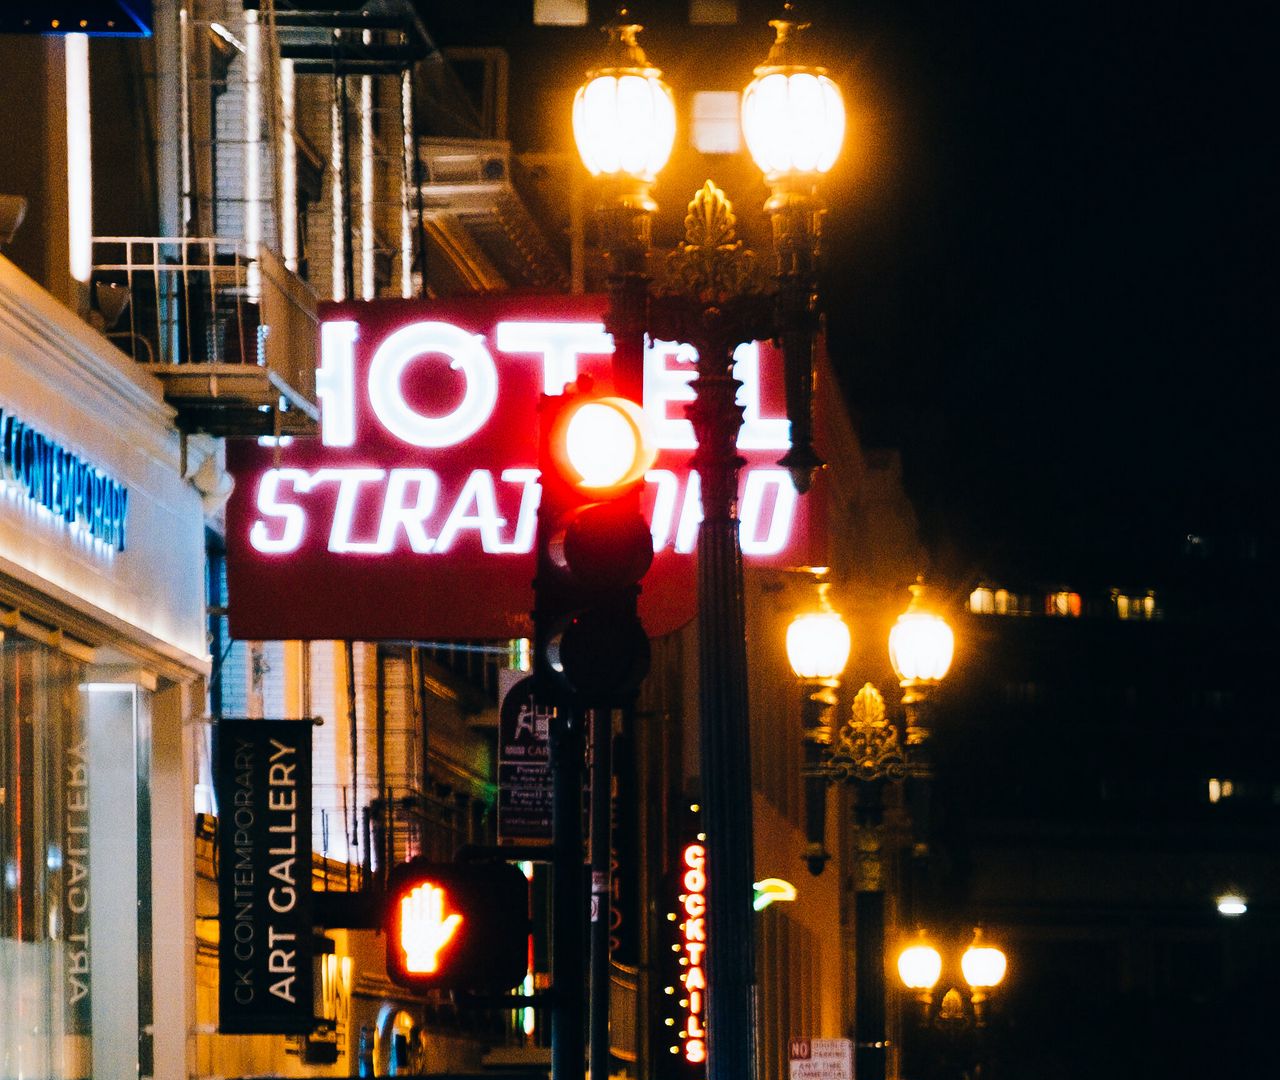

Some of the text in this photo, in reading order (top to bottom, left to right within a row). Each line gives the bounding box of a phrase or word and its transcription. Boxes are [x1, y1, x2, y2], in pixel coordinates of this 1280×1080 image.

[234, 738, 254, 960] CONTEMPORARY
[268, 738, 297, 1004] ART GALLERY
[684, 844, 706, 1063] COCKTAILS
